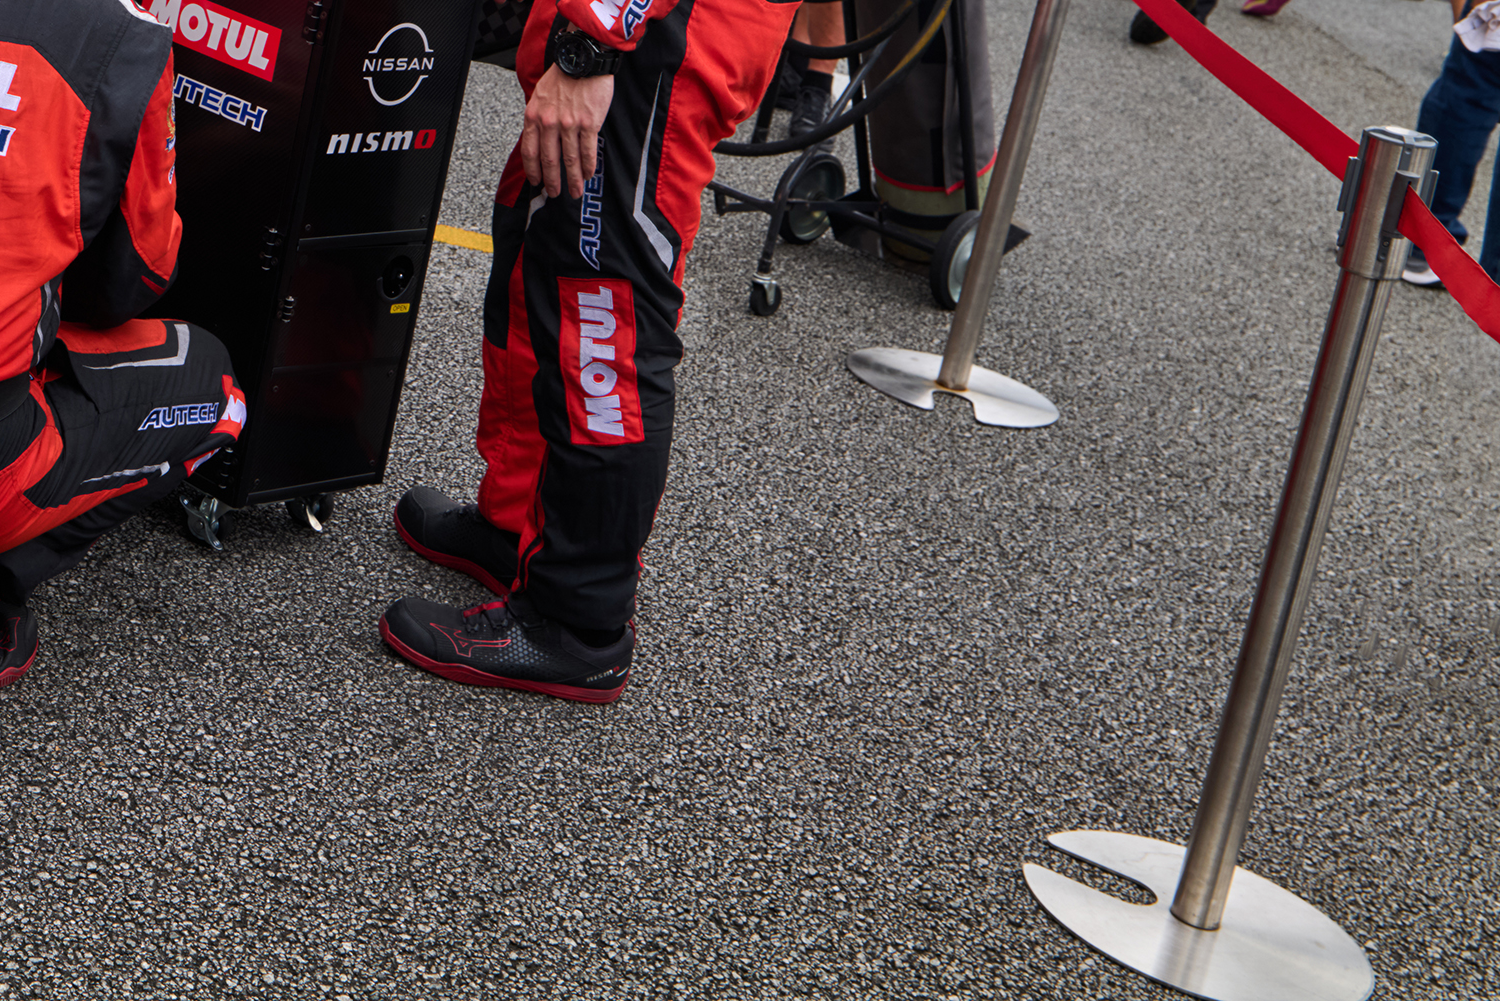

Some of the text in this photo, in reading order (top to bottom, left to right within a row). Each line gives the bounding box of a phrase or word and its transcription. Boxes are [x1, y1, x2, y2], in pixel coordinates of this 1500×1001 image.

[363, 55, 434, 73] NISSAN
[326, 129, 436, 155] nismo
[578, 286, 625, 437] MOTUL
[138, 401, 219, 431] AUTECH
